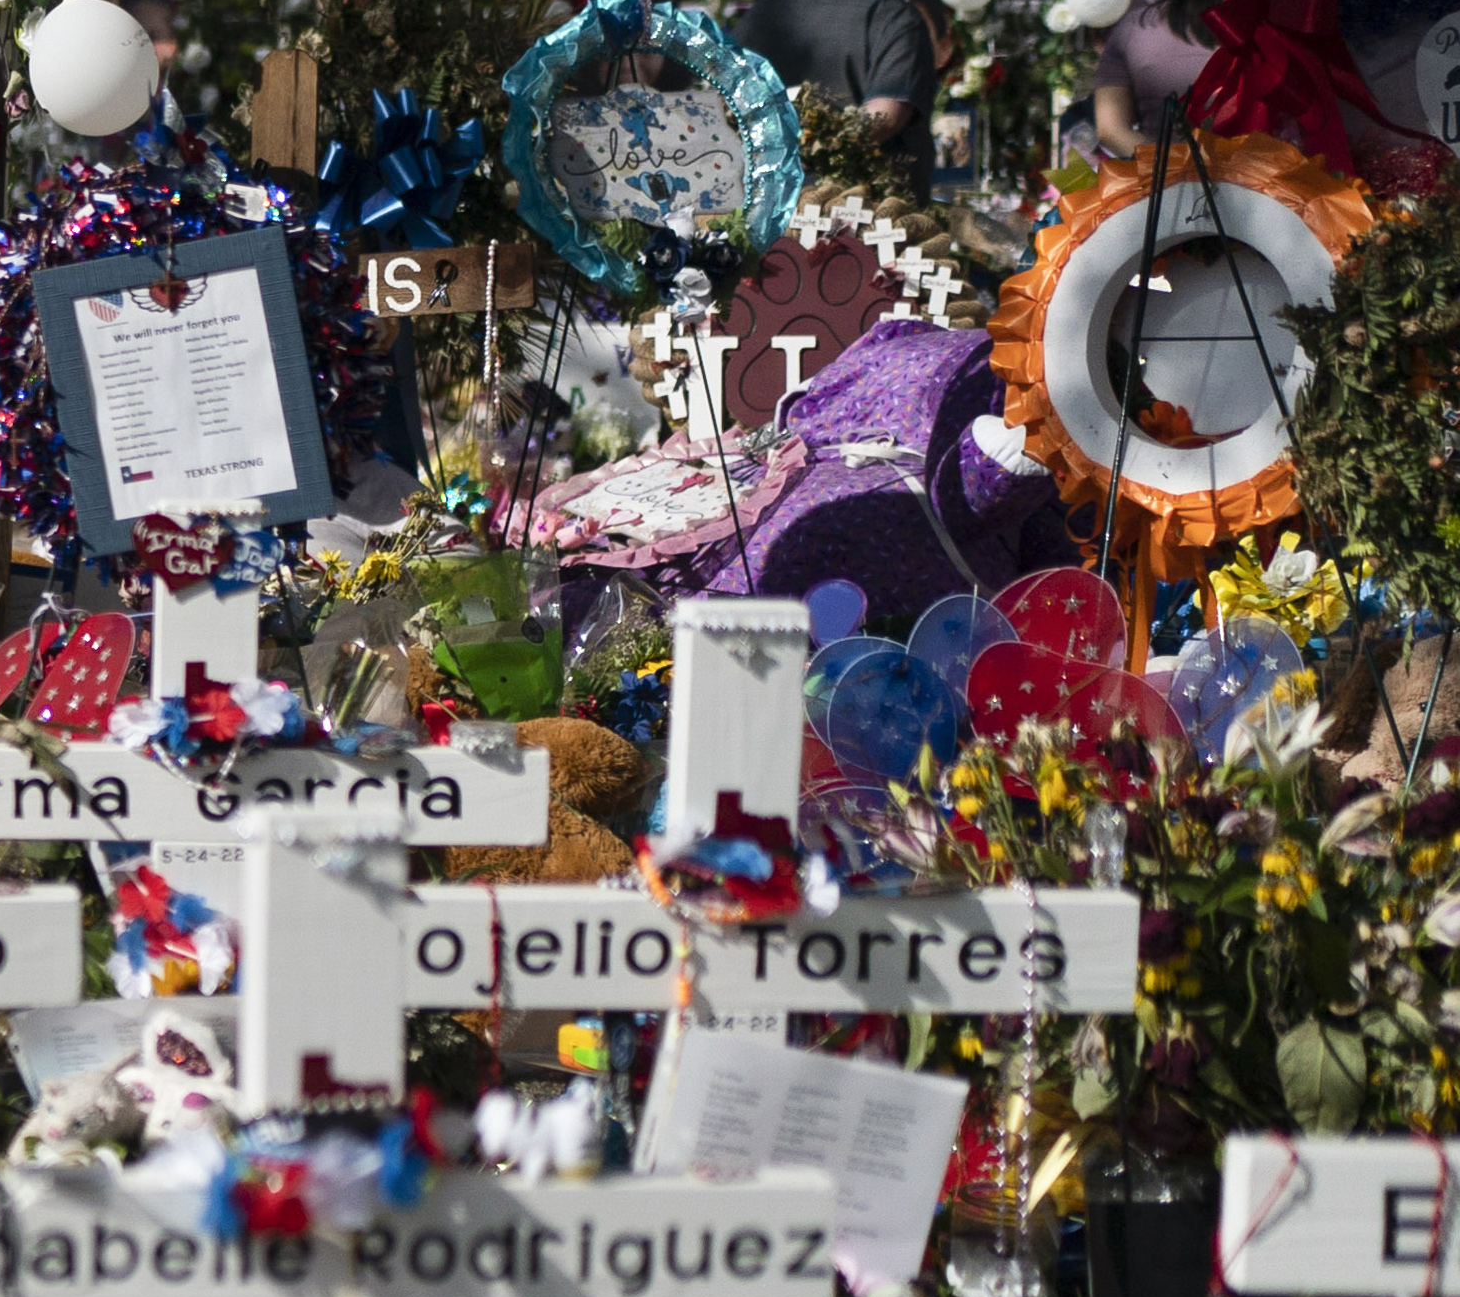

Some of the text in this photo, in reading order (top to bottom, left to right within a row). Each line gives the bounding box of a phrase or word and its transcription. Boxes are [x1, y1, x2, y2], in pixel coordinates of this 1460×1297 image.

[367, 257, 421, 316] IS
[112, 313, 241, 344] We will never forget you
[184, 457, 264, 479] TEXAS STRONG
[145, 531, 216, 554] Irma
[233, 537, 277, 573] Joe
[162, 848, 245, 864] 5-24-22
[416, 919, 1069, 997] ojelio Torres
[1383, 1185, 1439, 1264] E
[355, 1222, 827, 1294] Rodriguez
